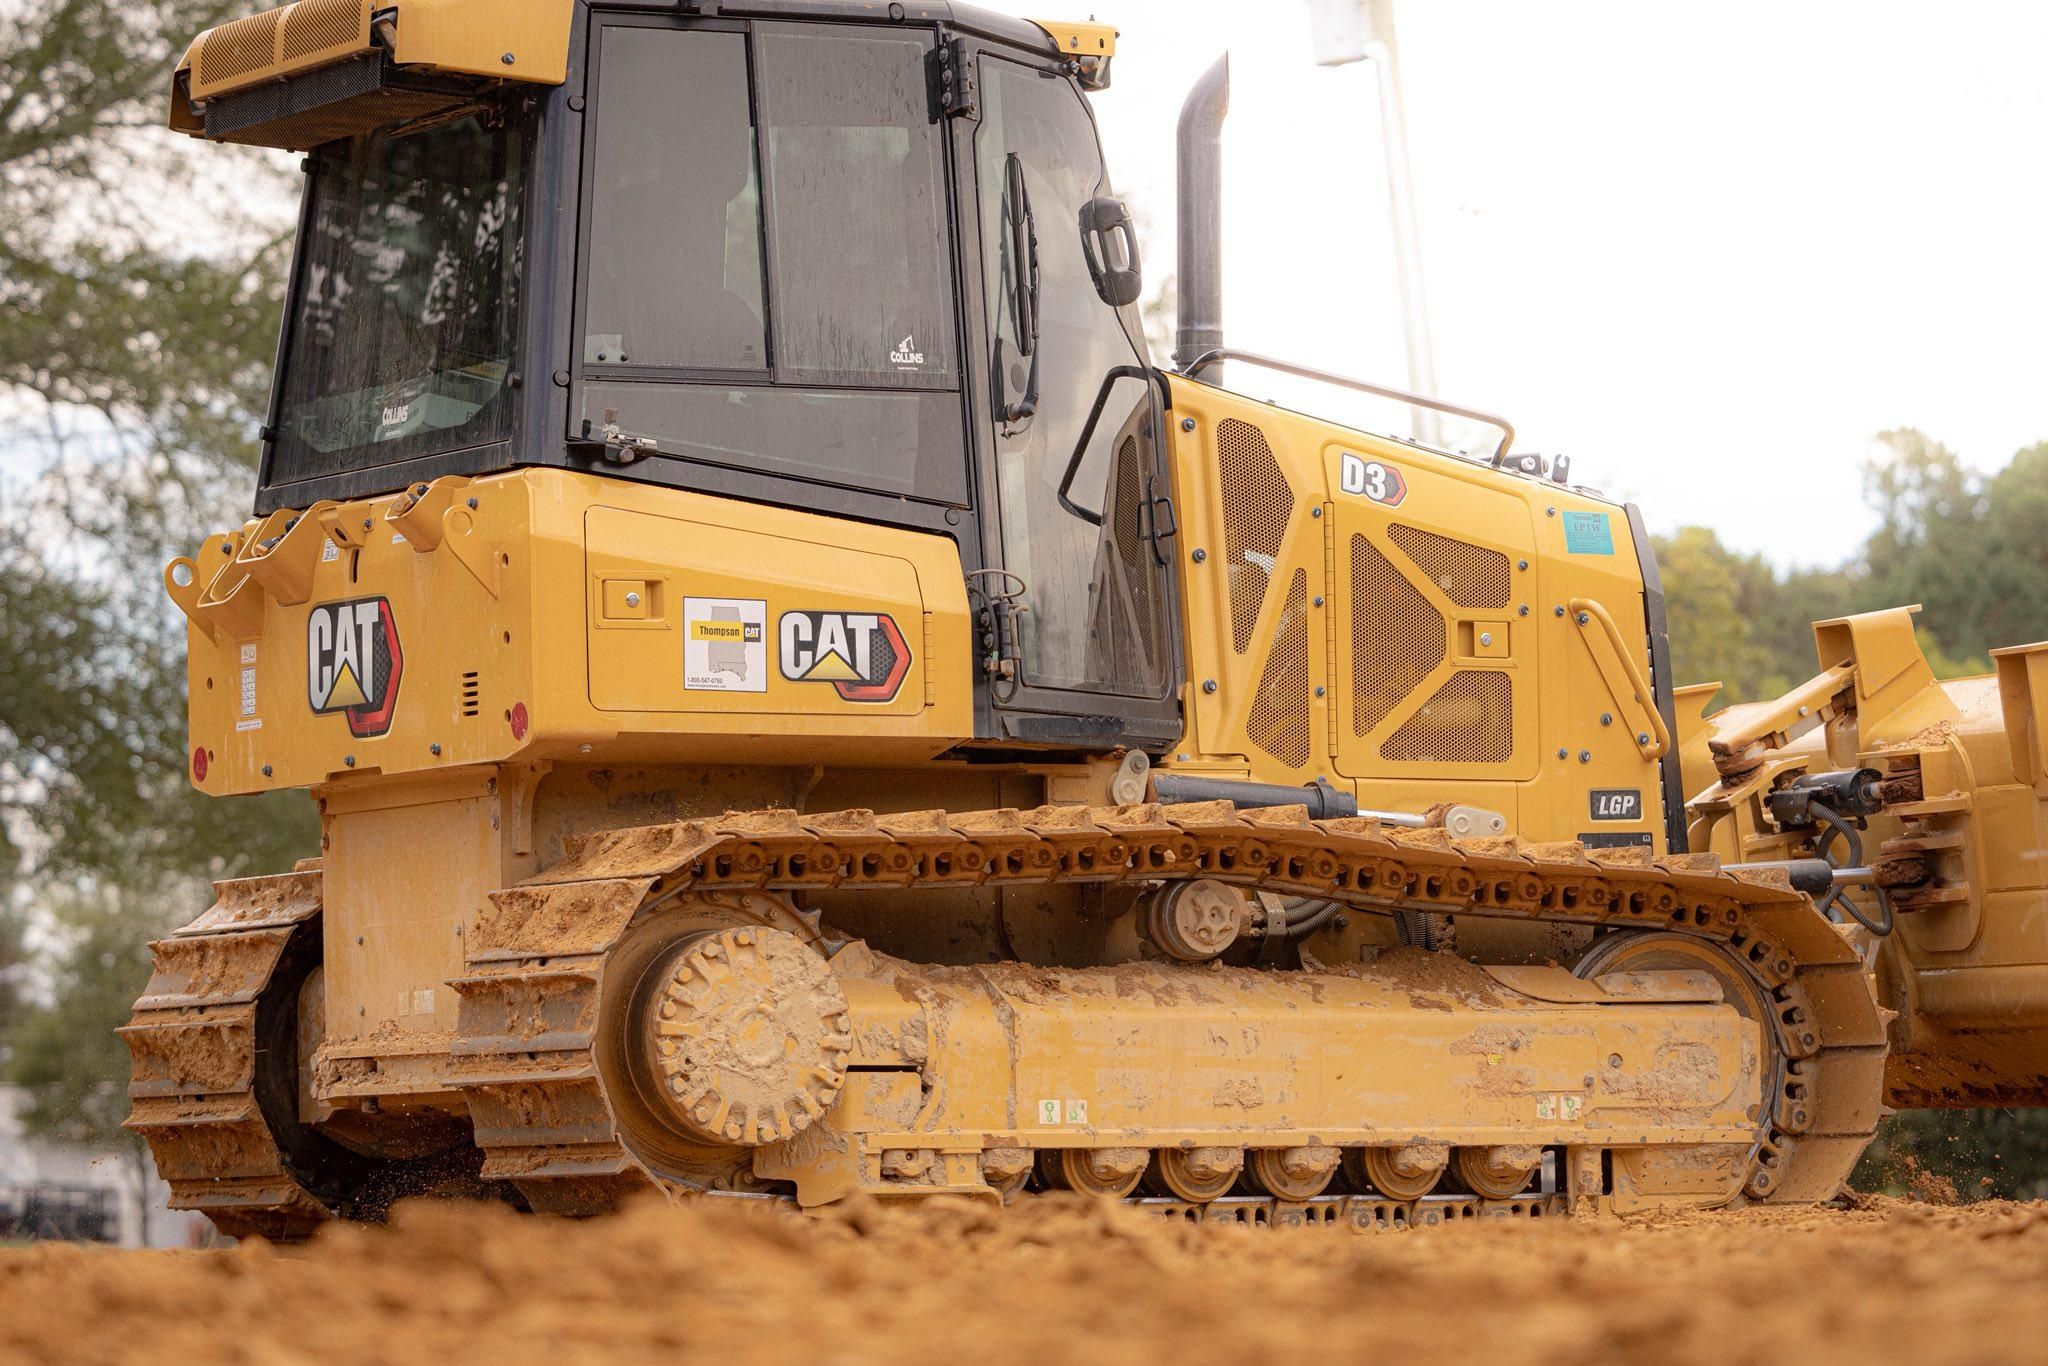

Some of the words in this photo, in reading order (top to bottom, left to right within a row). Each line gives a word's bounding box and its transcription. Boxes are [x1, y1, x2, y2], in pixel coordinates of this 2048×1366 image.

[891, 350, 924, 364] COLLINS
[1341, 453, 1387, 501] D3
[699, 625, 741, 637] Thompson
[745, 627, 760, 638] CAT
[780, 612, 879, 681] CAT
[309, 601, 379, 710] CAT
[1598, 795, 1635, 815] LGP
